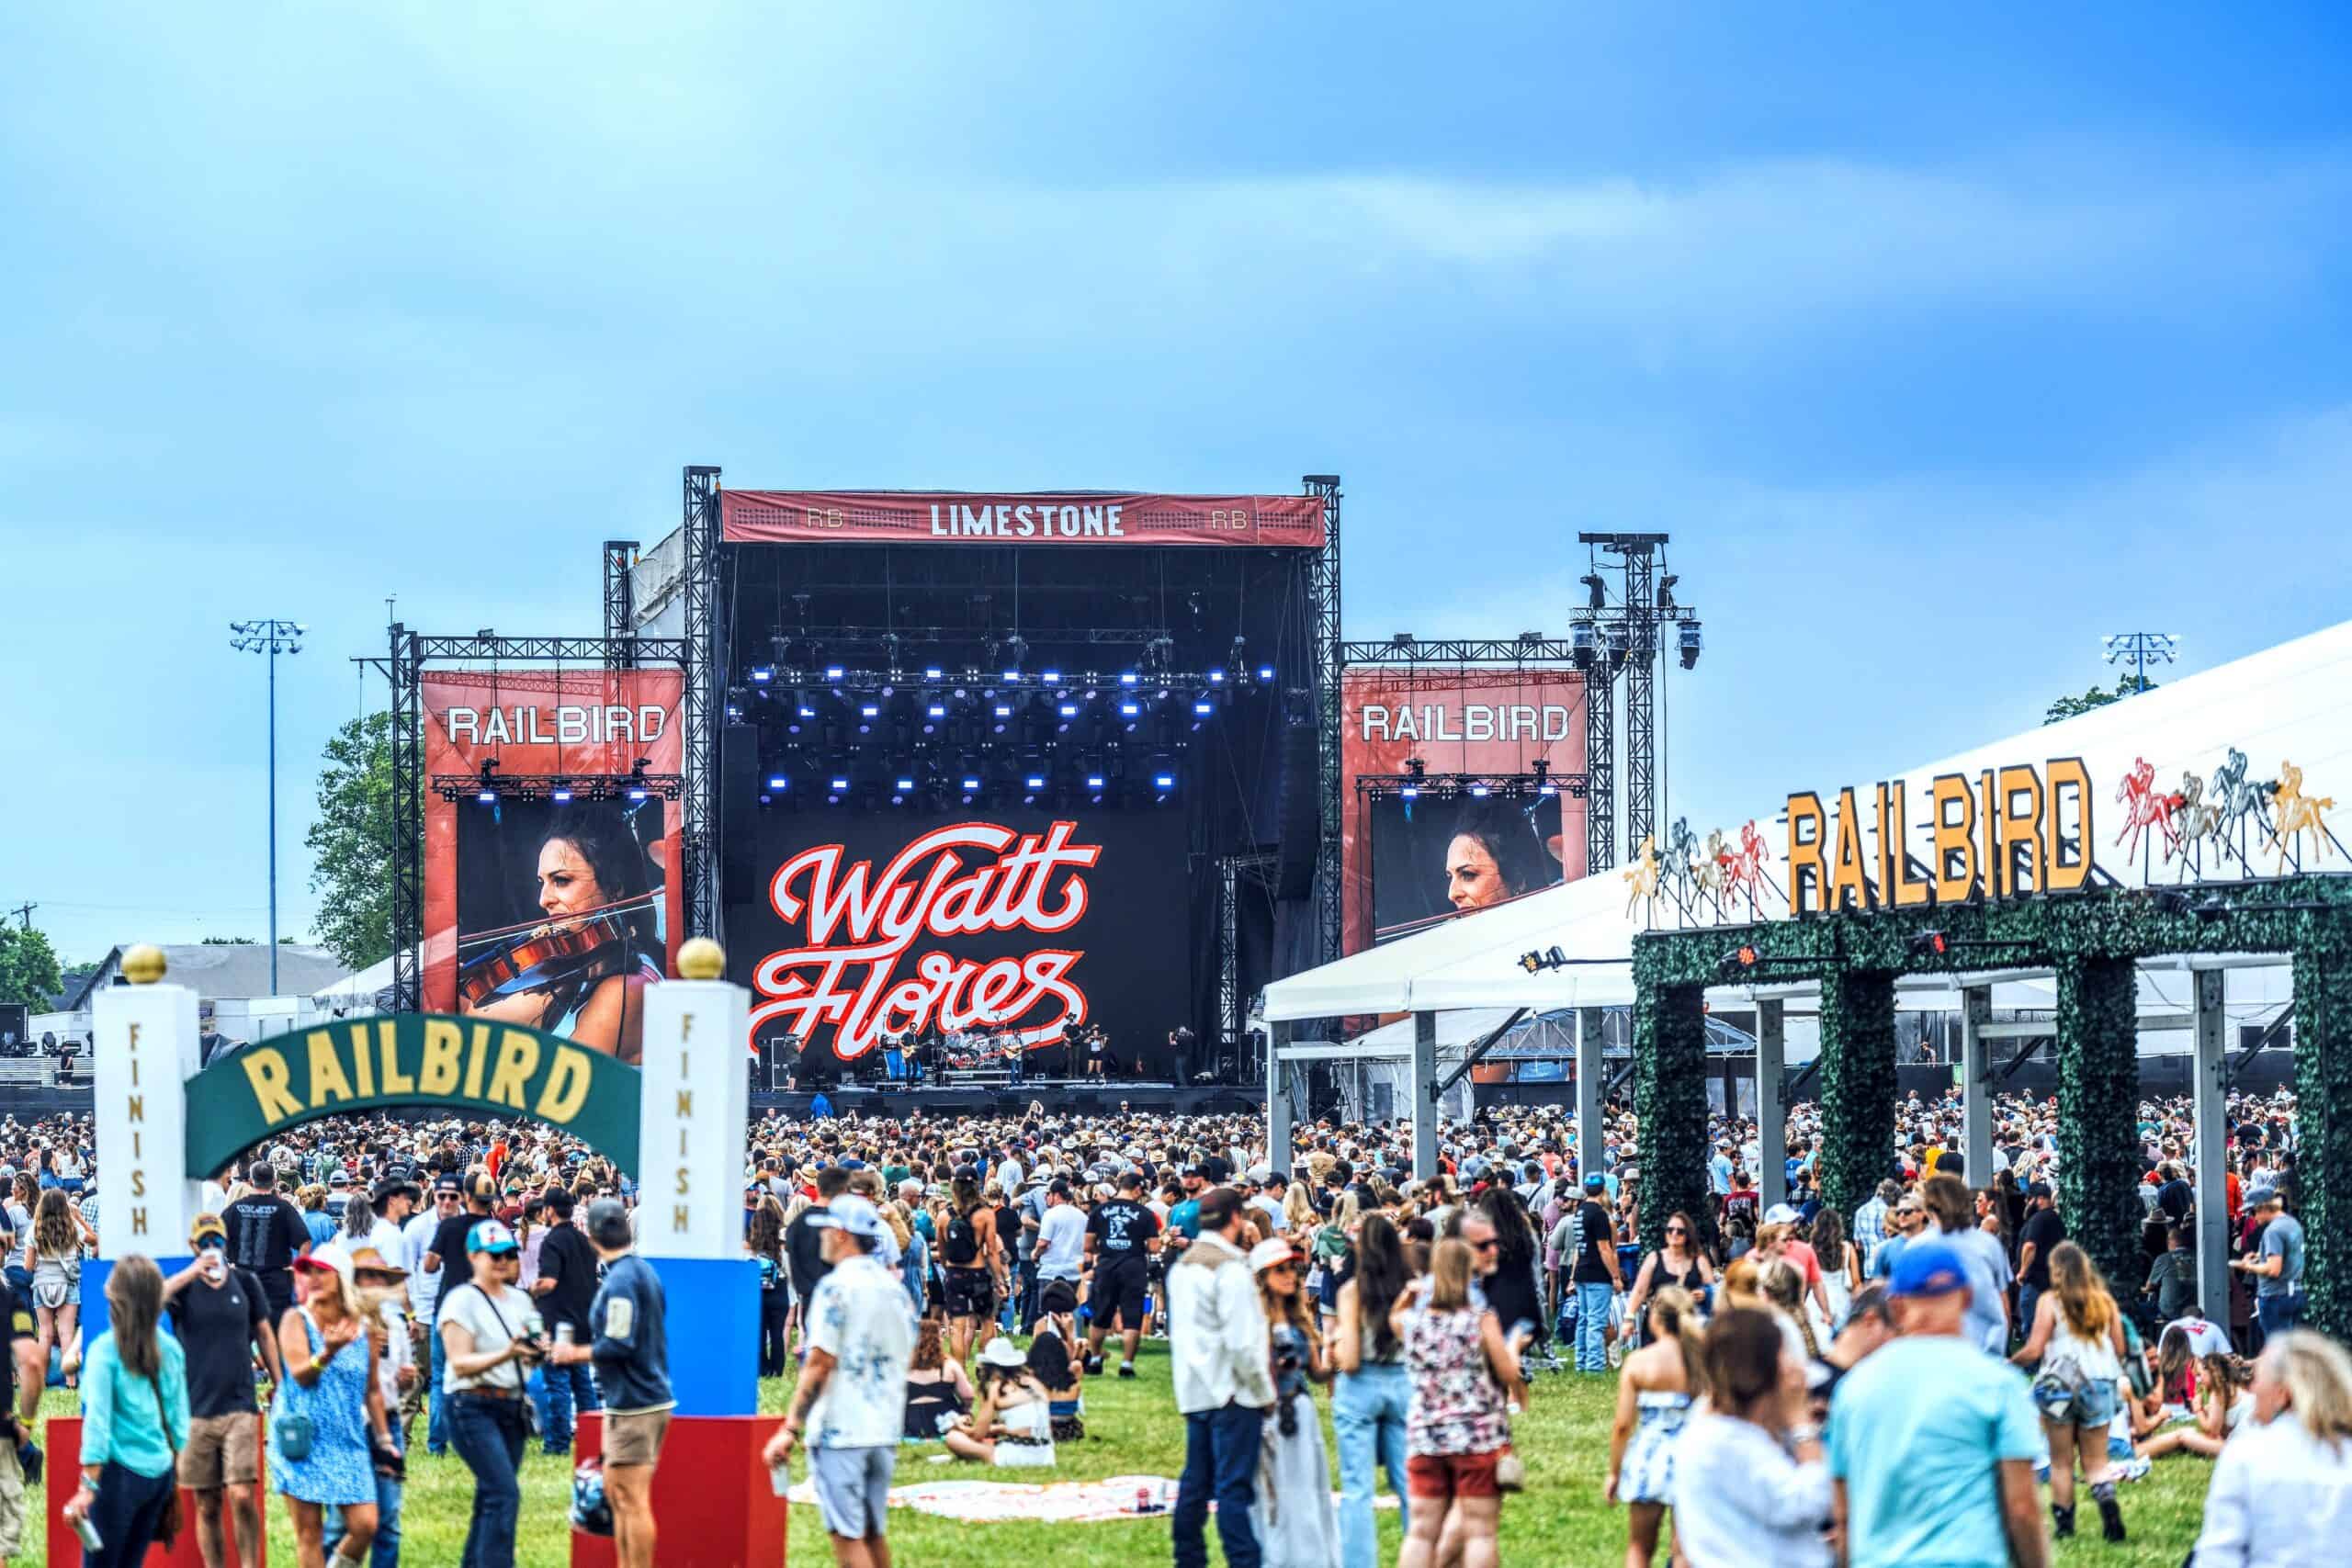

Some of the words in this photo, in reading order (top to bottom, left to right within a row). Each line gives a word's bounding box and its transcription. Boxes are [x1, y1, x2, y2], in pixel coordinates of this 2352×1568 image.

[807, 507, 843, 528] RB
[930, 504, 1125, 537] LIMESTONE
[1212, 510, 1247, 530] RB
[447, 705, 667, 745] RAILBIRD
[1362, 705, 1570, 741] RAILBIRD
[769, 820, 1102, 953] Wyatt
[1786, 757, 2095, 919] RAILBIRD
[749, 946, 1089, 1062] Flores
[128, 1022, 148, 1236] FINISH
[241, 1020, 593, 1126] RAILBIRD
[673, 1013, 696, 1234] FINISH
